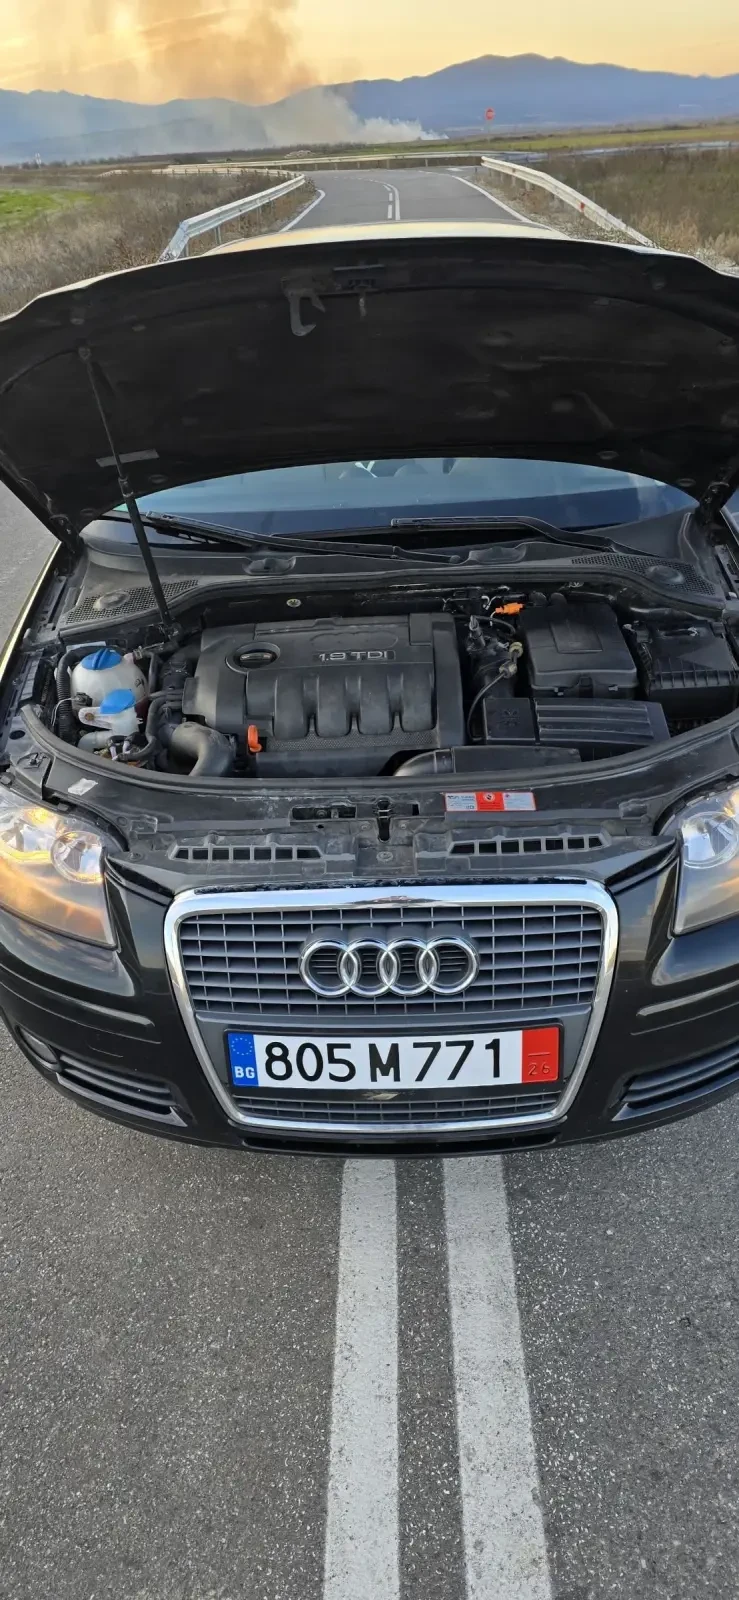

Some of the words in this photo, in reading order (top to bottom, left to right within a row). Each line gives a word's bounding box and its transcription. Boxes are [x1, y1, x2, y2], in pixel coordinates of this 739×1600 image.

[319, 652, 347, 662] 1.9
[350, 650, 388, 661] TDI
[265, 1041, 356, 1082] 805
[368, 1042, 401, 1082] M
[412, 1038, 500, 1082] 771
[234, 1065, 256, 1079] BG
[528, 1061, 551, 1076] 26
